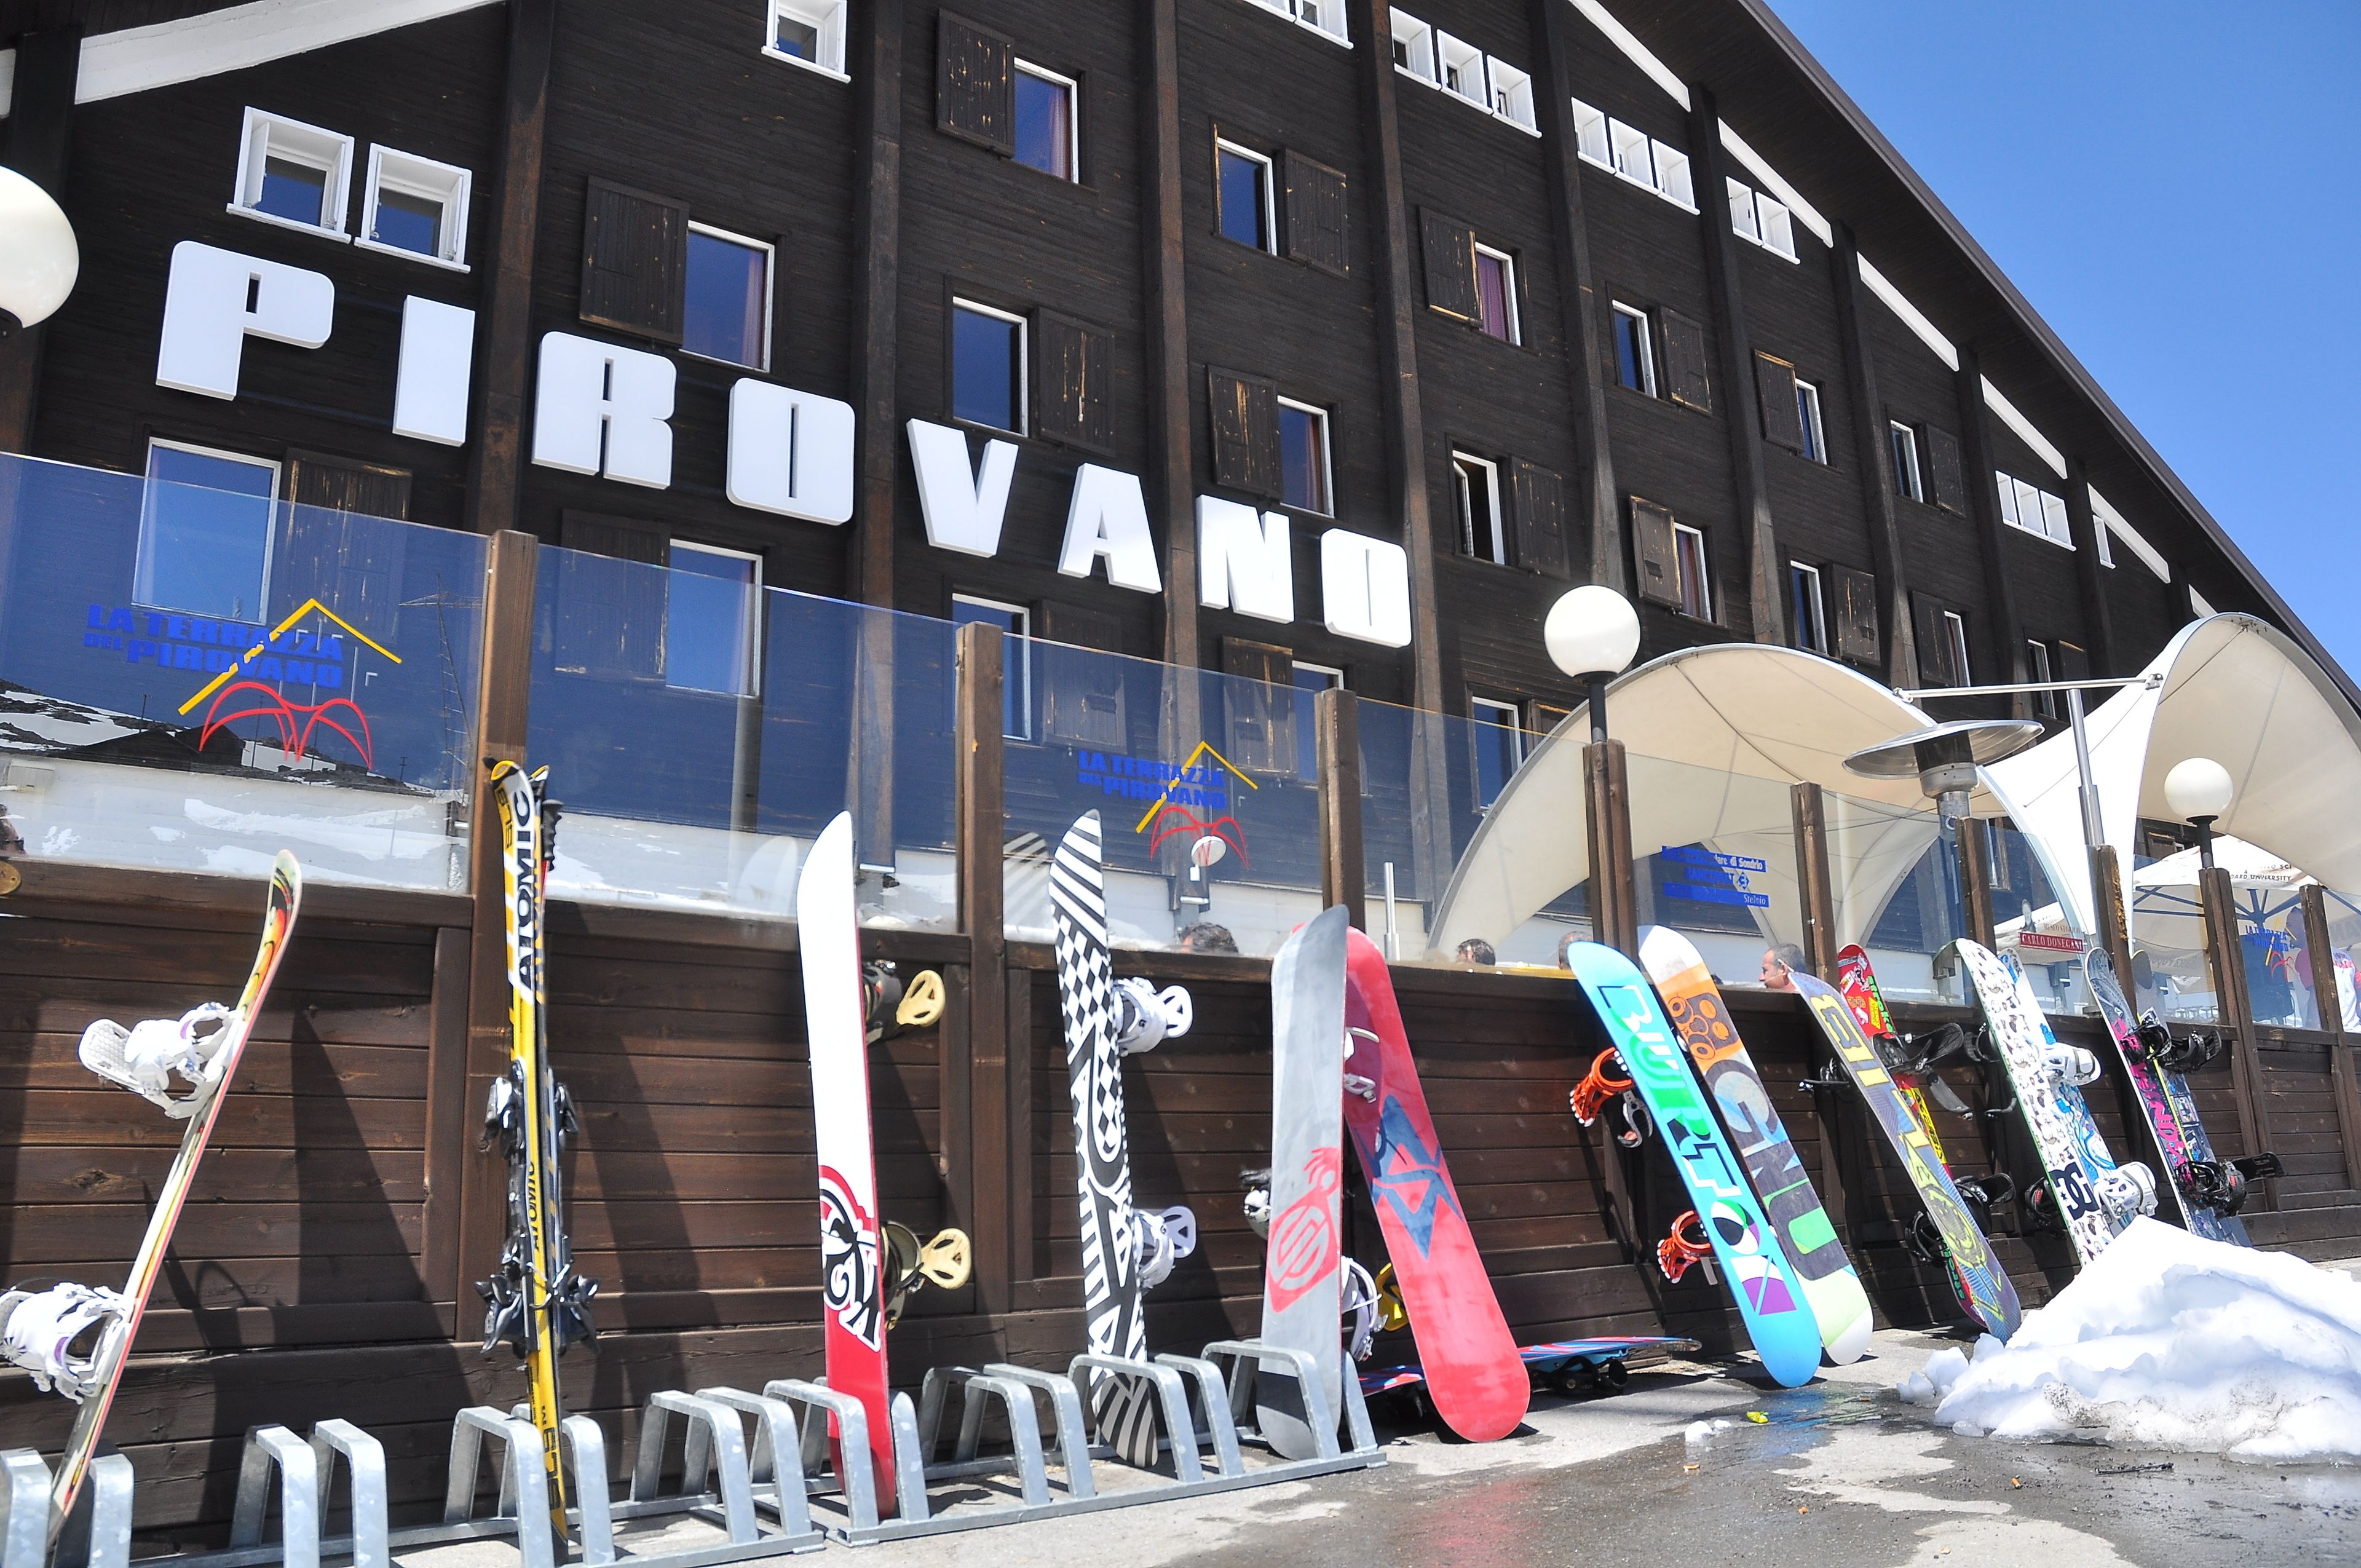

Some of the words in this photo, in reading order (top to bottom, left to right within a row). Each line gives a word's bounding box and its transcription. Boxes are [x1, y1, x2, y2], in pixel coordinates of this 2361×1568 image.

[157, 242, 1412, 647] PIROVANO
[84, 632, 122, 650] DEL
[126, 639, 344, 689] PIROVANO
[87, 604, 135, 633] LA
[143, 611, 344, 662] TERRAZZA
[1079, 750, 1107, 771] LA
[1110, 754, 1225, 788] TERRAZZA
[1104, 776, 1226, 809] PIROVANO
[1730, 857, 1738, 866] di
[513, 791, 536, 991] ATOMIC
[2022, 933, 2046, 946] CARLO
[2047, 938, 2082, 951] DONEGANI
[1597, 984, 1797, 1317] BURTON
[1705, 1059, 1858, 1281] GNU
